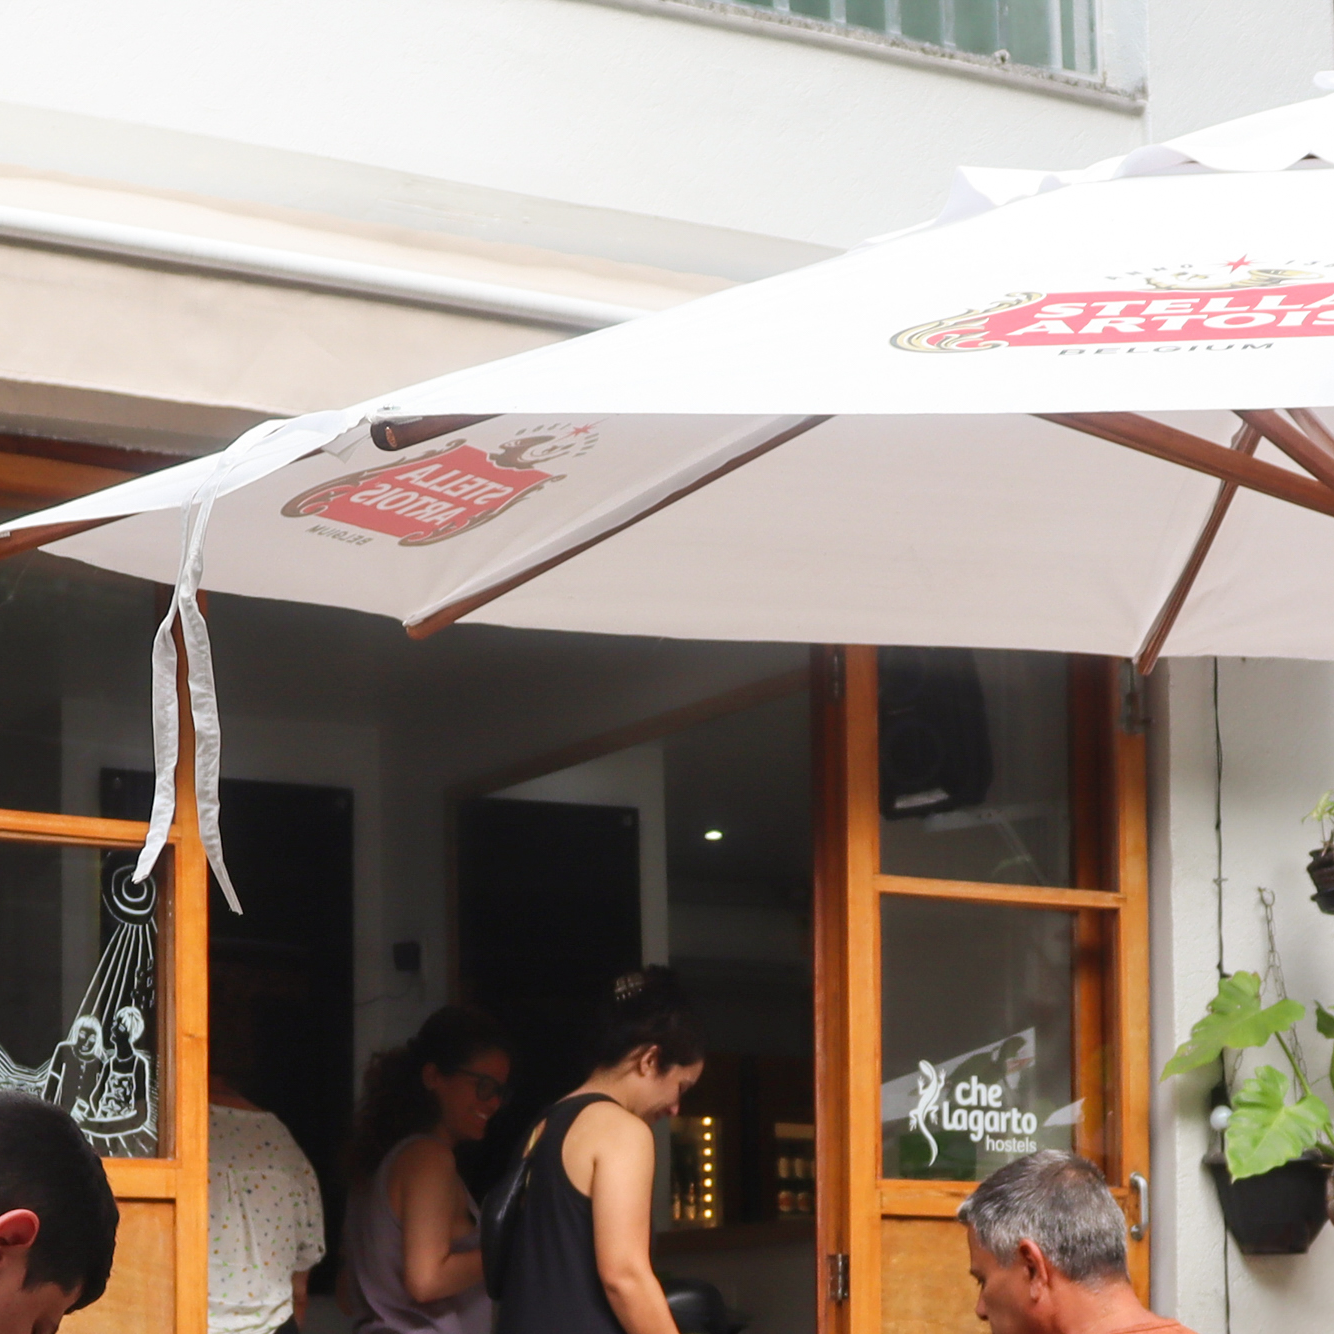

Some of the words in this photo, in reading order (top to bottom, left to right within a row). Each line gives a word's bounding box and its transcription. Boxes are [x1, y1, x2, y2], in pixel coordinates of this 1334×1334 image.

[1057, 341, 1275, 356] BELGIUM
[954, 1075, 1003, 1108] che
[985, 1134, 1038, 1153] hostels
